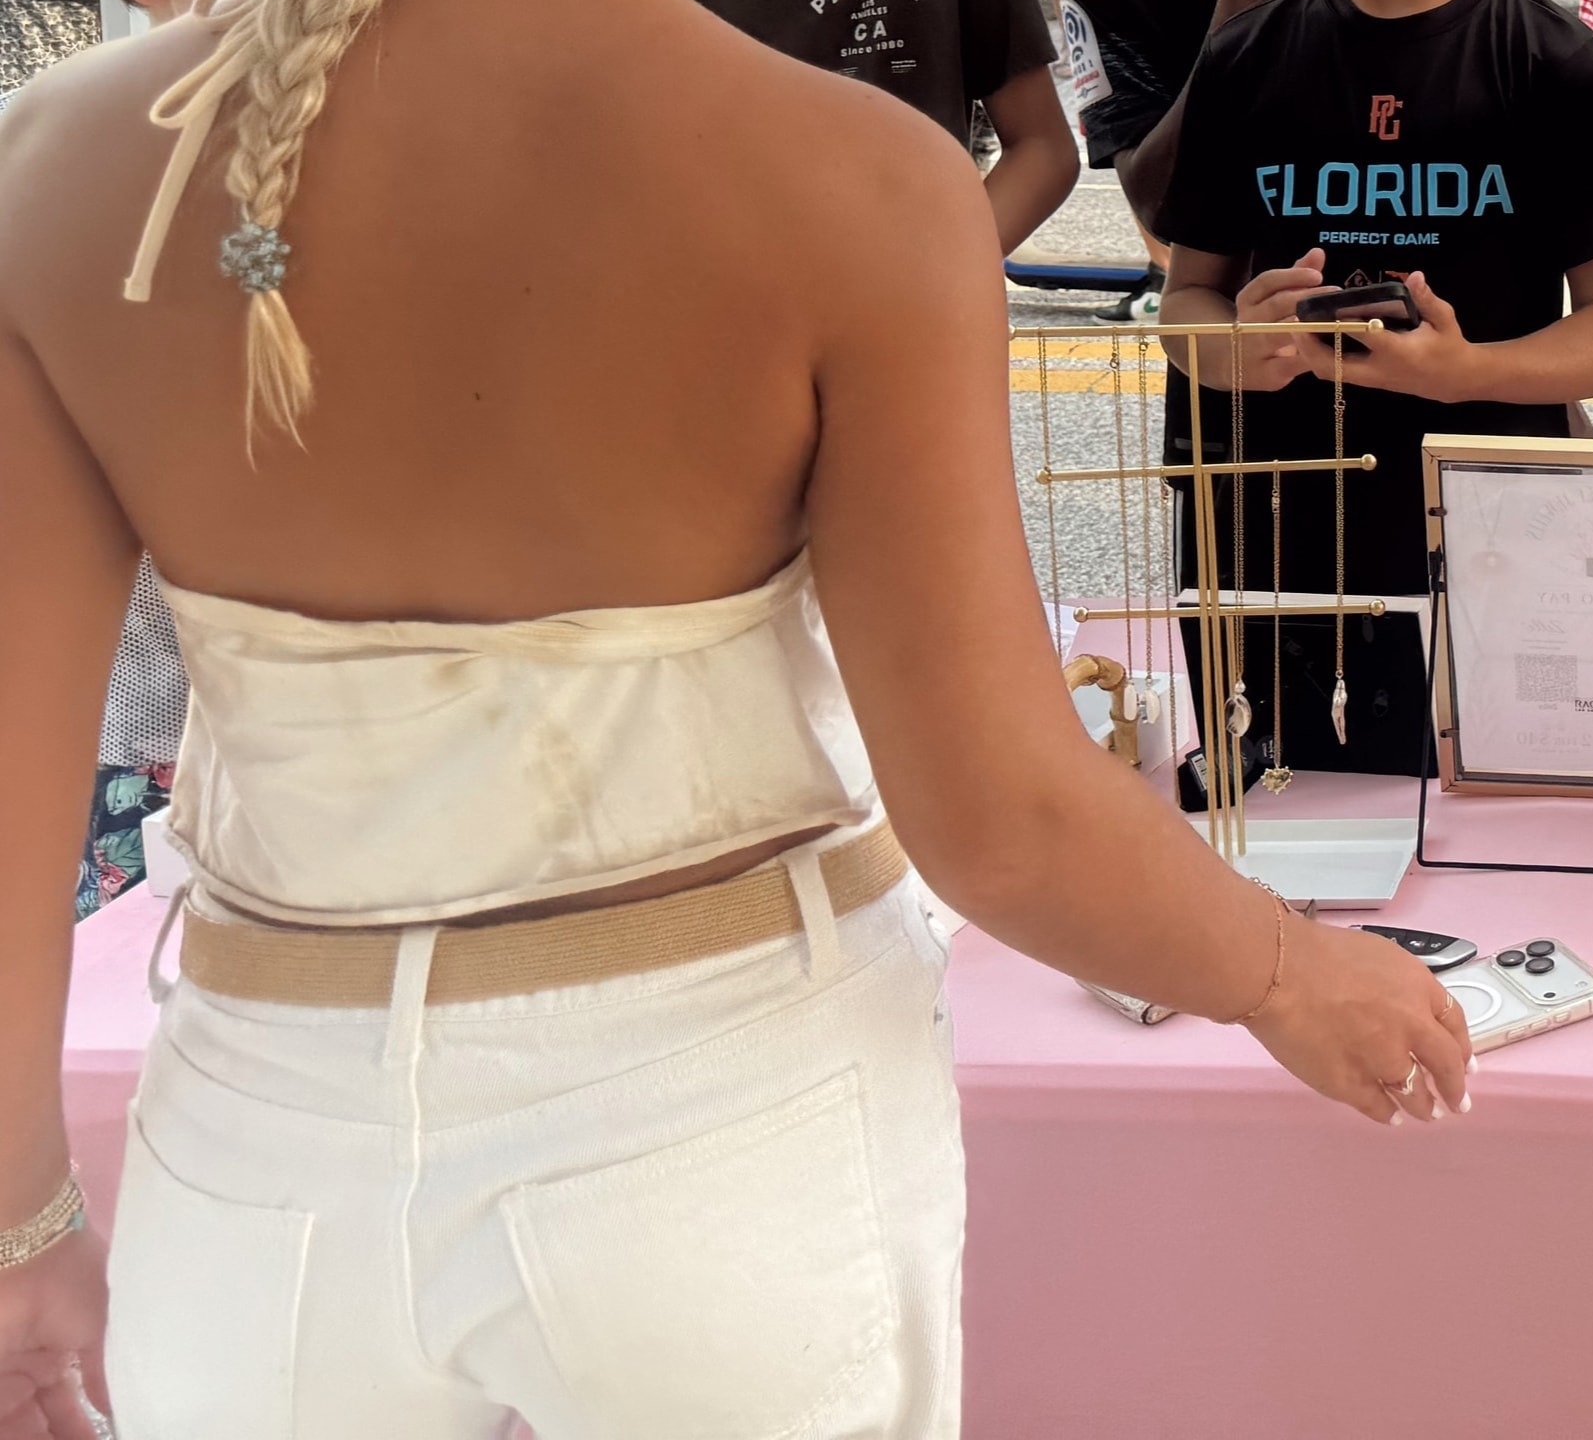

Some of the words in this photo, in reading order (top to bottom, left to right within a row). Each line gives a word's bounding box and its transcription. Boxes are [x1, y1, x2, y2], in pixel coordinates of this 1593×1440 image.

[1368, 94, 1404, 141] PG
[1255, 162, 1515, 217] FLORIDA
[1319, 231, 1390, 245] PERFECT
[1393, 232, 1440, 246] GAME
